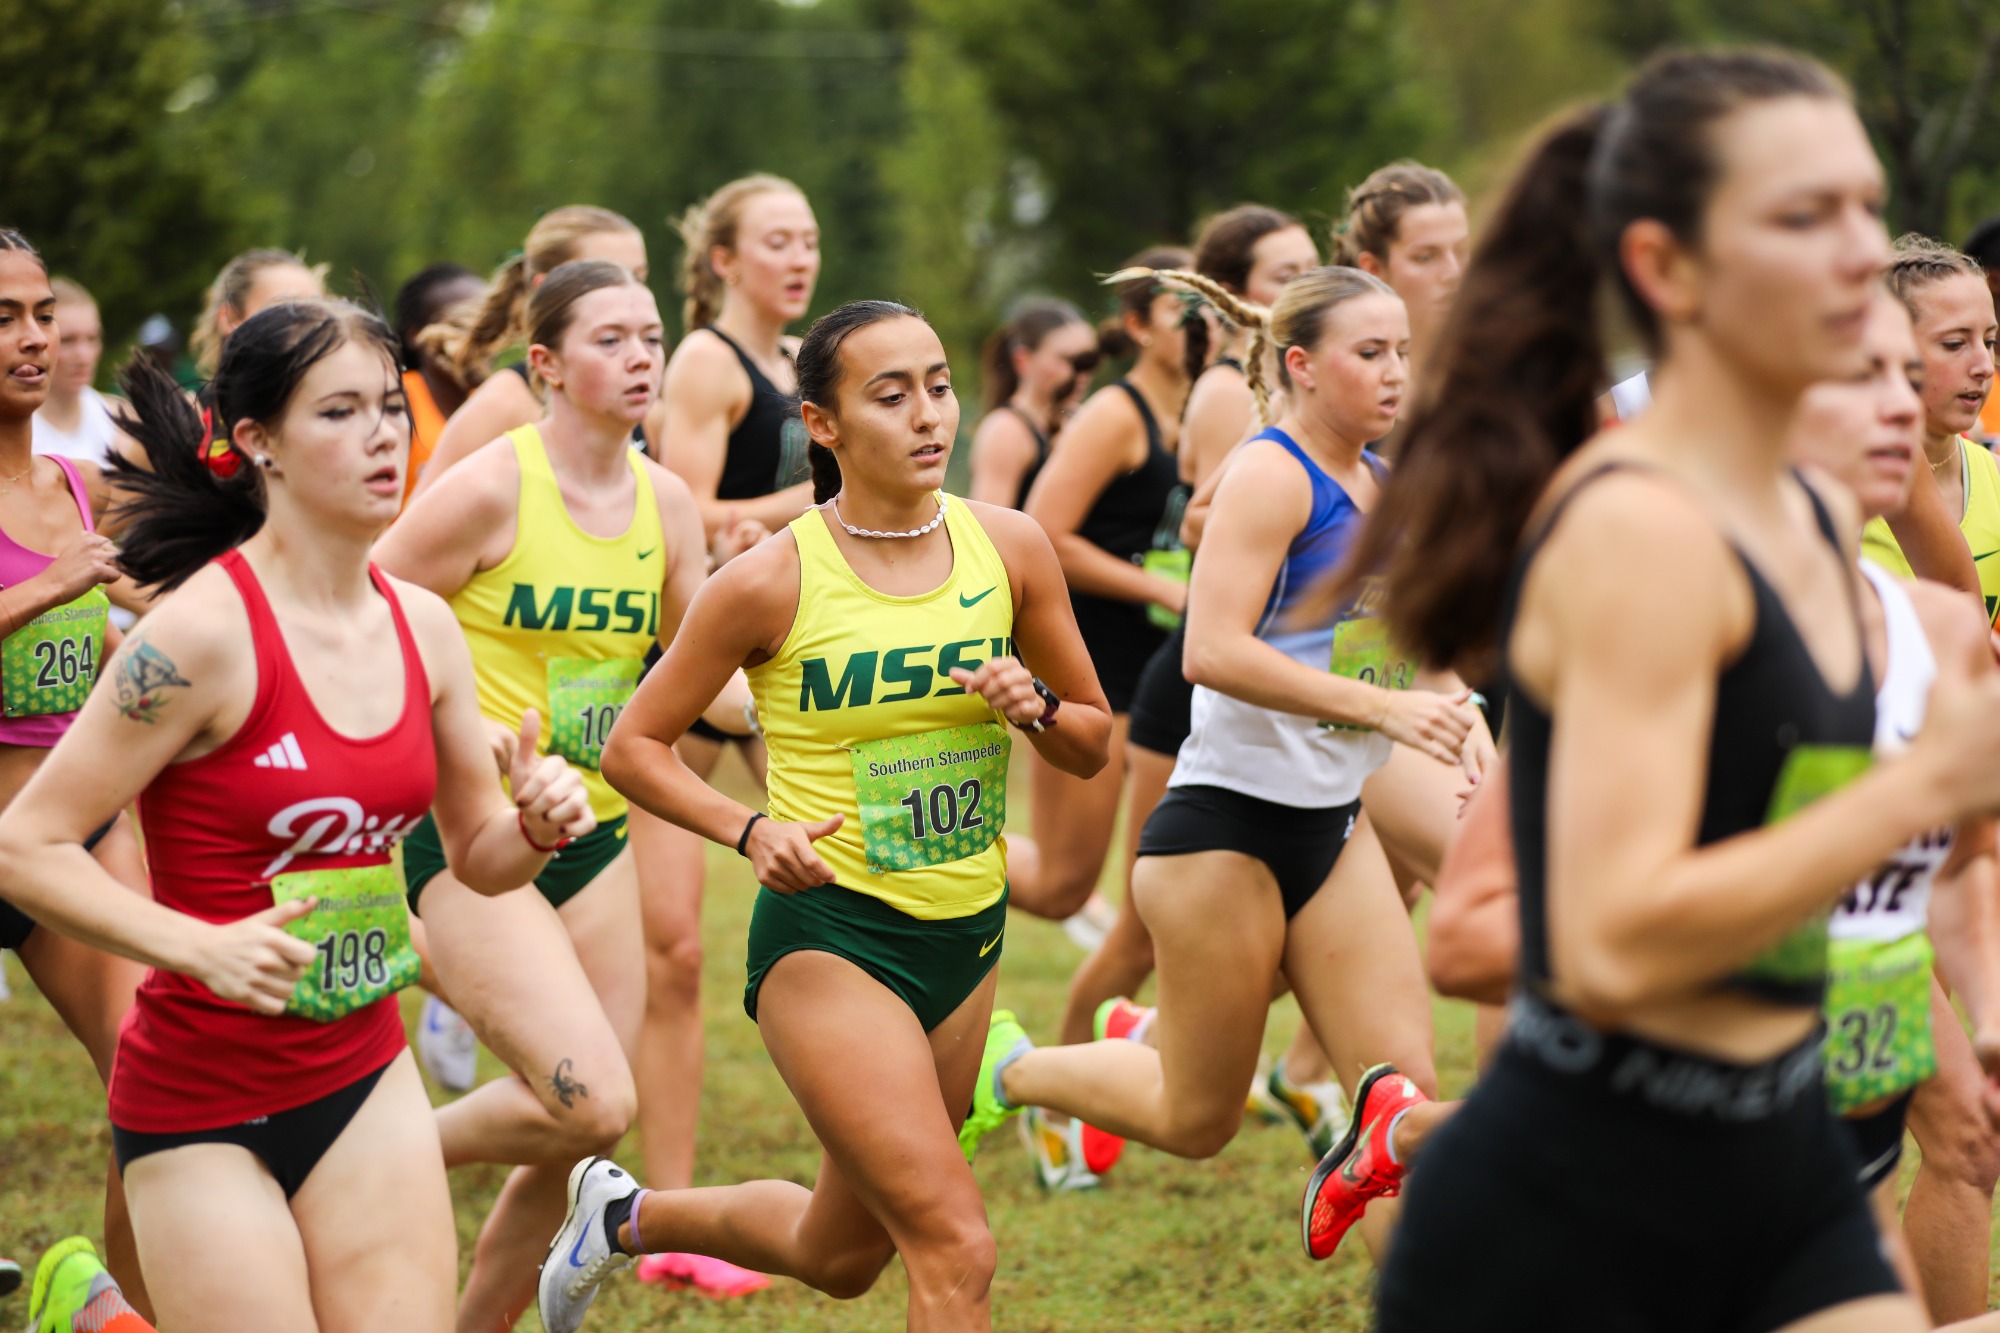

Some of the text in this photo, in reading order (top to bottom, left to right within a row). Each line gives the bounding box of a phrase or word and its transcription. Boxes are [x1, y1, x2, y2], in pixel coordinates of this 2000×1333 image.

[34, 634, 95, 688] 264
[580, 704, 625, 748] 10
[868, 743, 1002, 778] Southern Stampede
[901, 778, 984, 840] 102
[316, 928, 390, 993] 198
